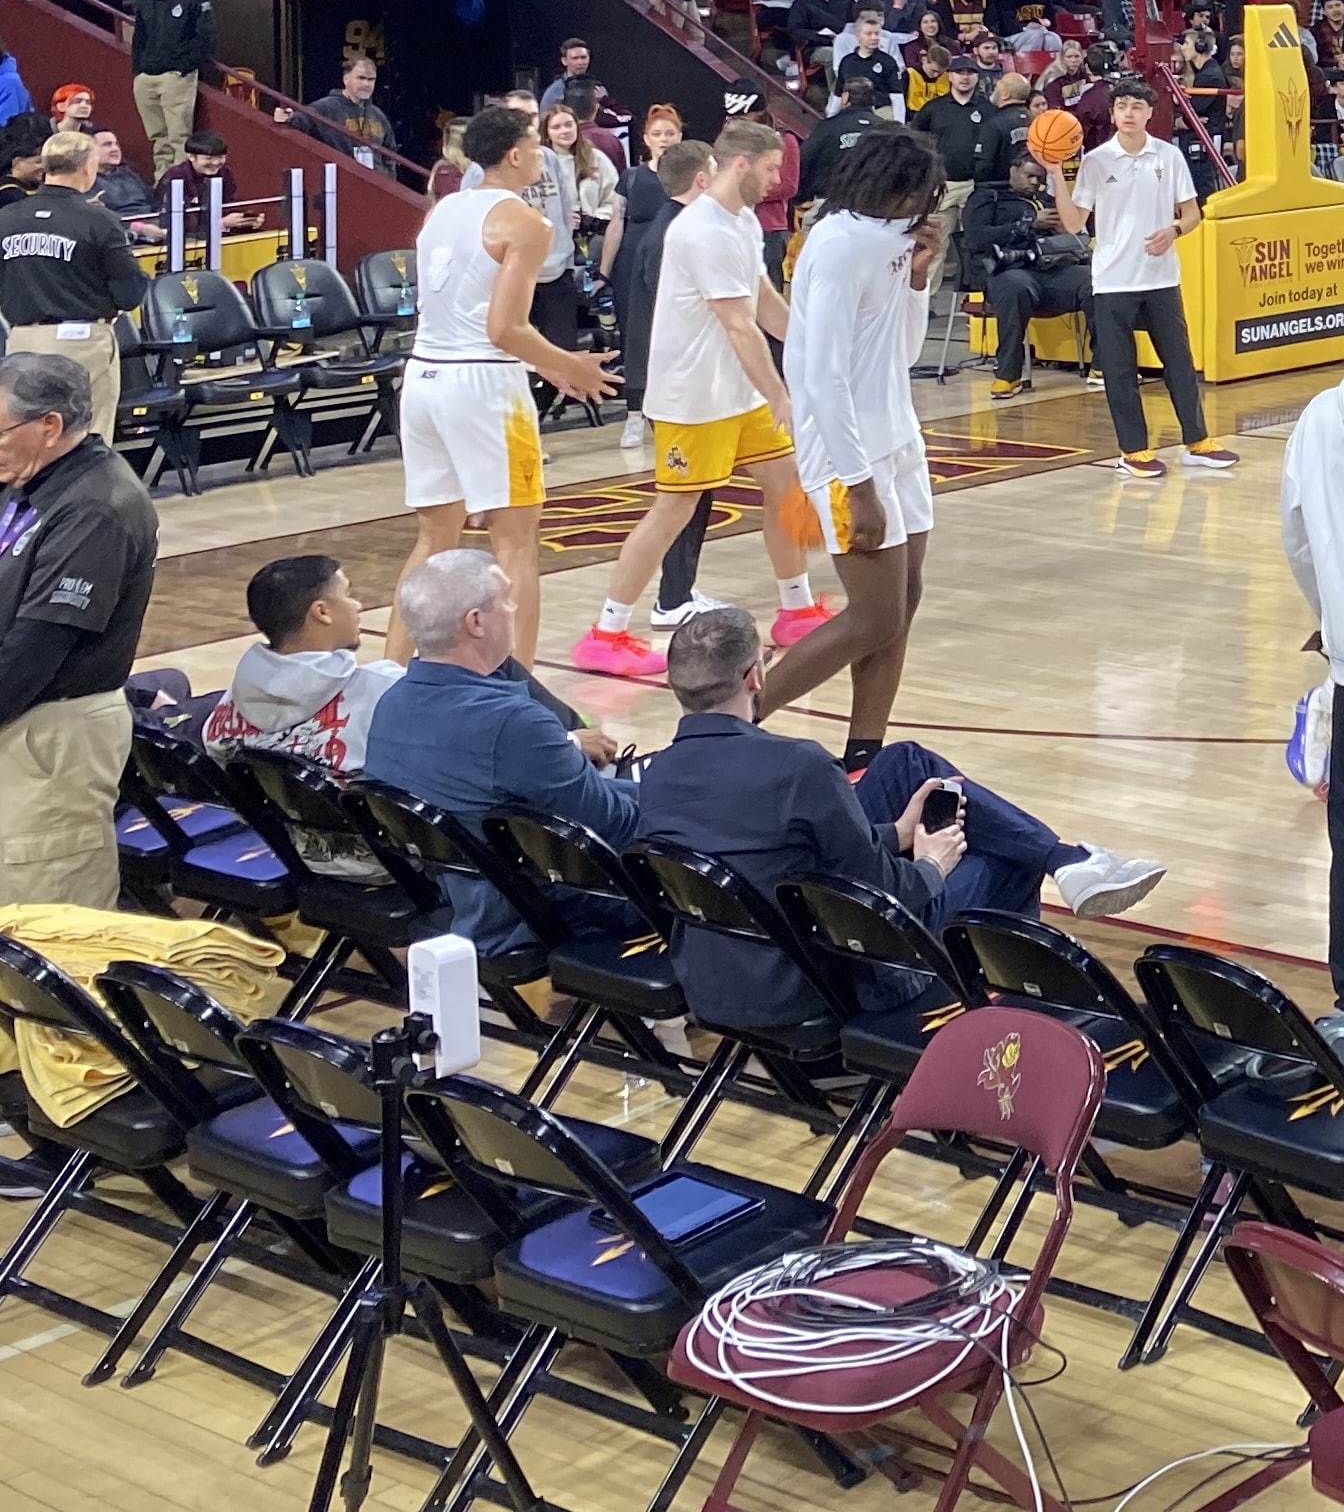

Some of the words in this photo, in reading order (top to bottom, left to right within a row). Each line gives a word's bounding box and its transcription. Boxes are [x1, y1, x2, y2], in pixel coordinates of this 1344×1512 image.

[2, 232, 76, 262] SECURITY
[1255, 239, 1290, 264] SUN
[1250, 260, 1293, 283] ANGEL
[1305, 261, 1324, 274] we
[1259, 291, 1286, 308] Join
[1288, 286, 1323, 302] today
[1325, 283, 1338, 297] at
